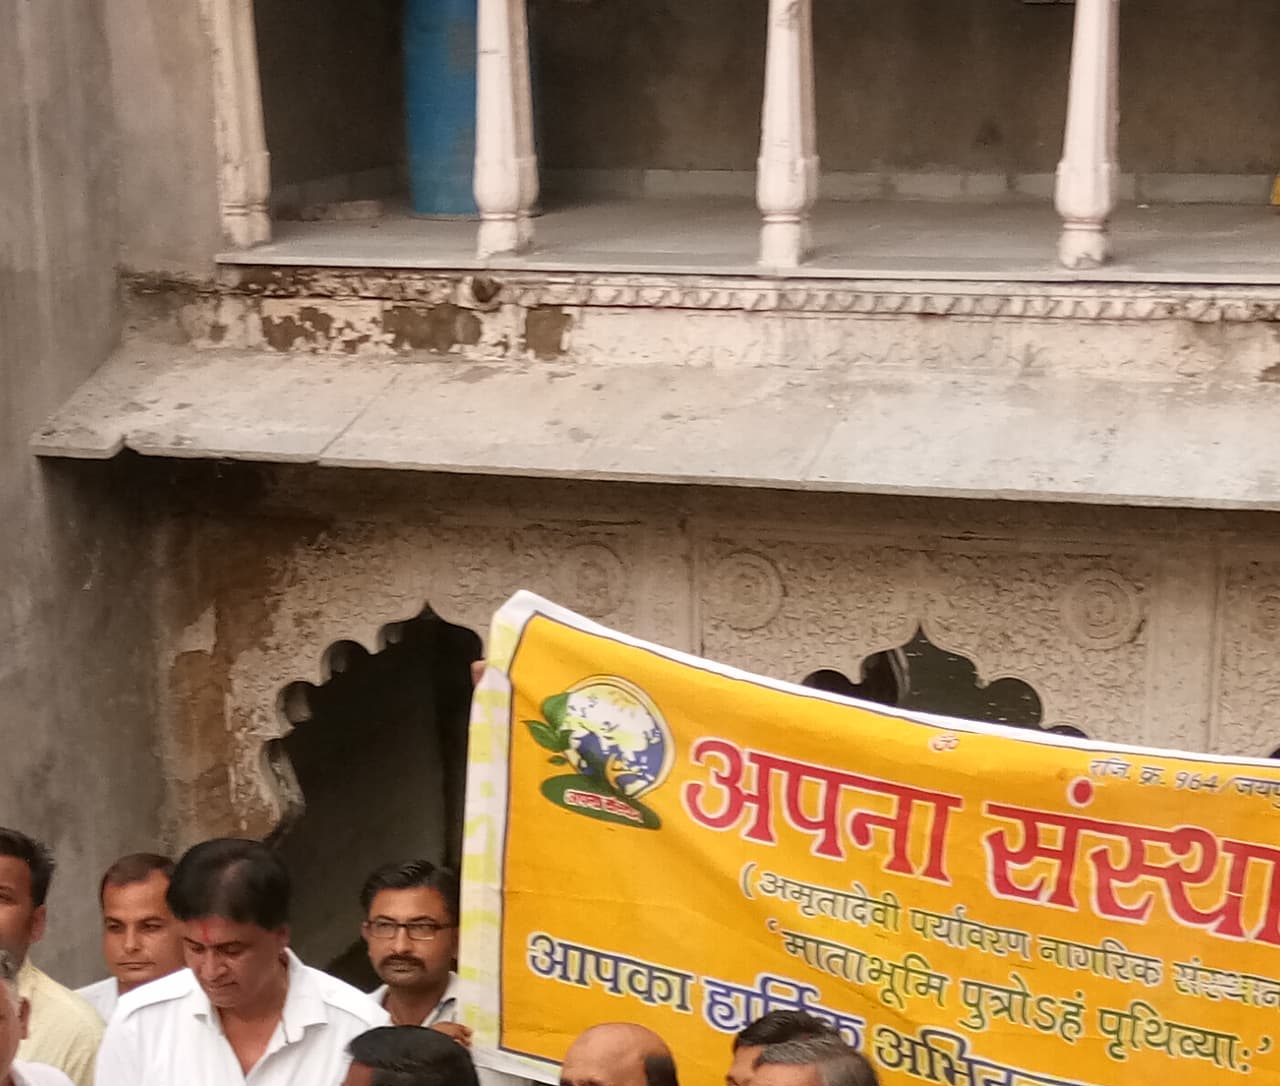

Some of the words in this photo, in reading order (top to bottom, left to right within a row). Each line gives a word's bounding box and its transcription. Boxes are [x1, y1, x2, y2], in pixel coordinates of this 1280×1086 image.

[683, 738, 963, 884] अपना
[528, 934, 693, 1012] आपका
[909, 906, 1029, 958] पर्यावरण
[1038, 938, 1161, 985] नागरिक
